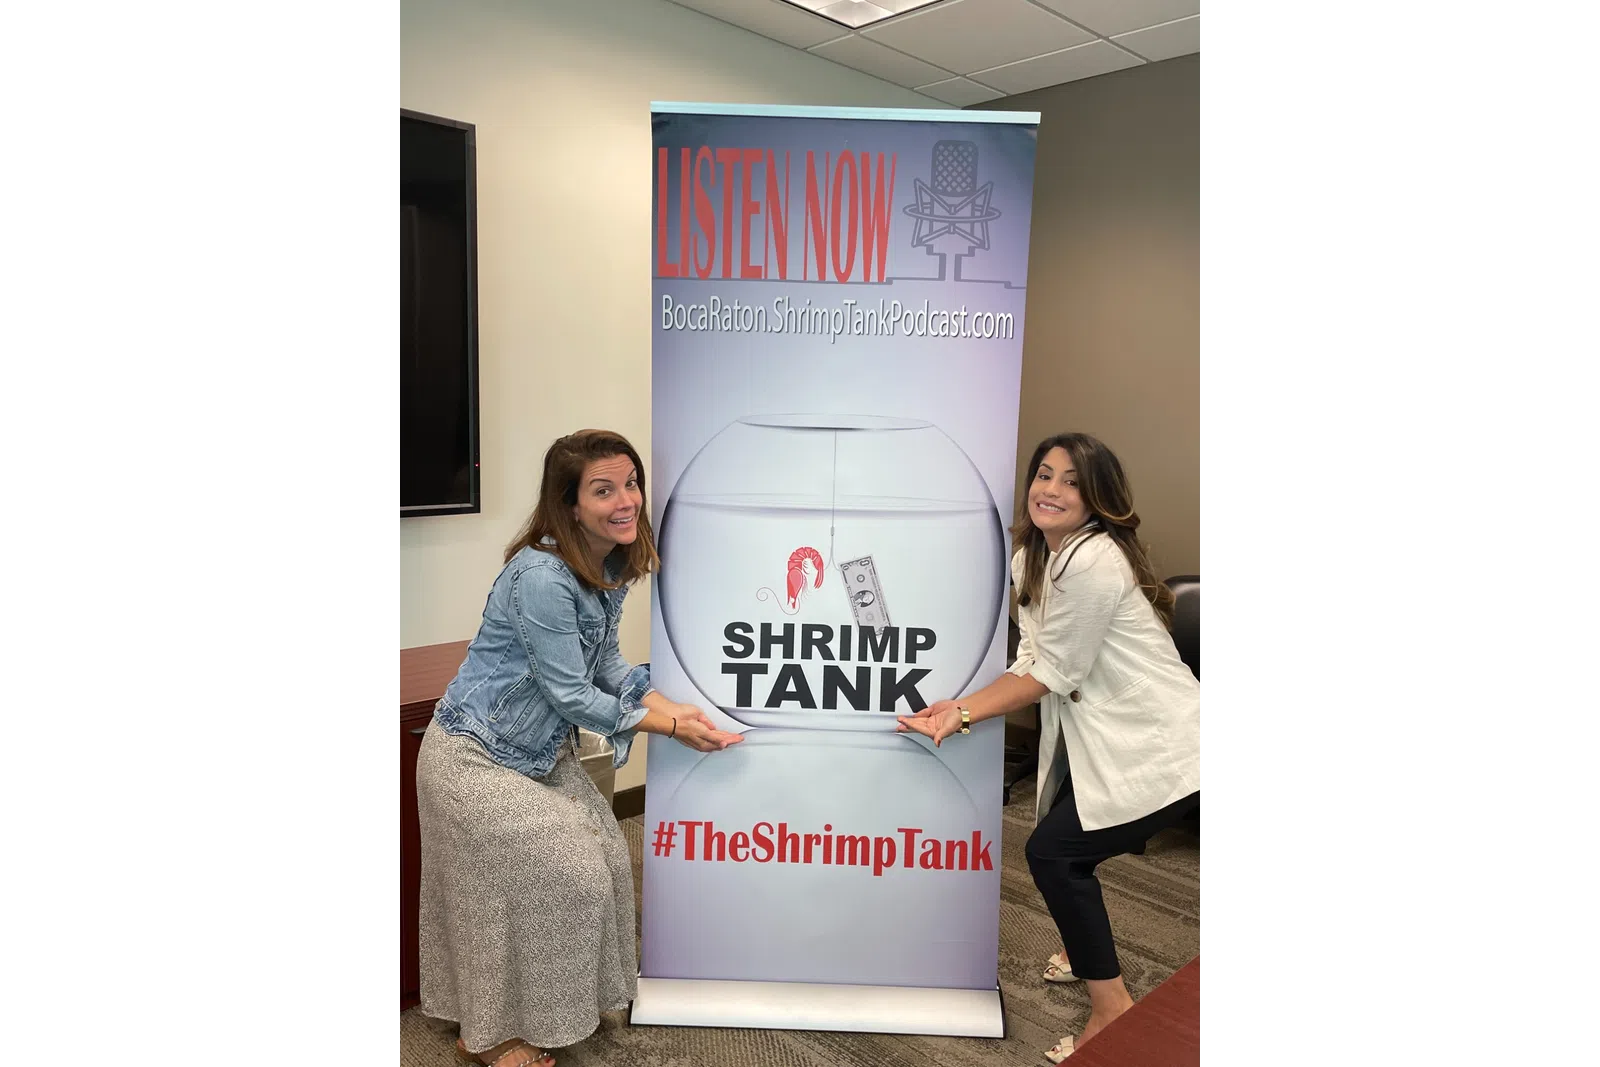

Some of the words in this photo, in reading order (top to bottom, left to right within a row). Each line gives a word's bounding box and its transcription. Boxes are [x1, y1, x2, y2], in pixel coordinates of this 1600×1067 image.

[657, 145, 791, 281] LISTEN
[803, 149, 897, 284] NOW
[661, 294, 1015, 344] BocaRaton.ShrimpTankPodcast.com
[722, 621, 937, 664] SHRIMP
[721, 662, 933, 714] TANK
[651, 820, 994, 877] #TheShrimpTank
